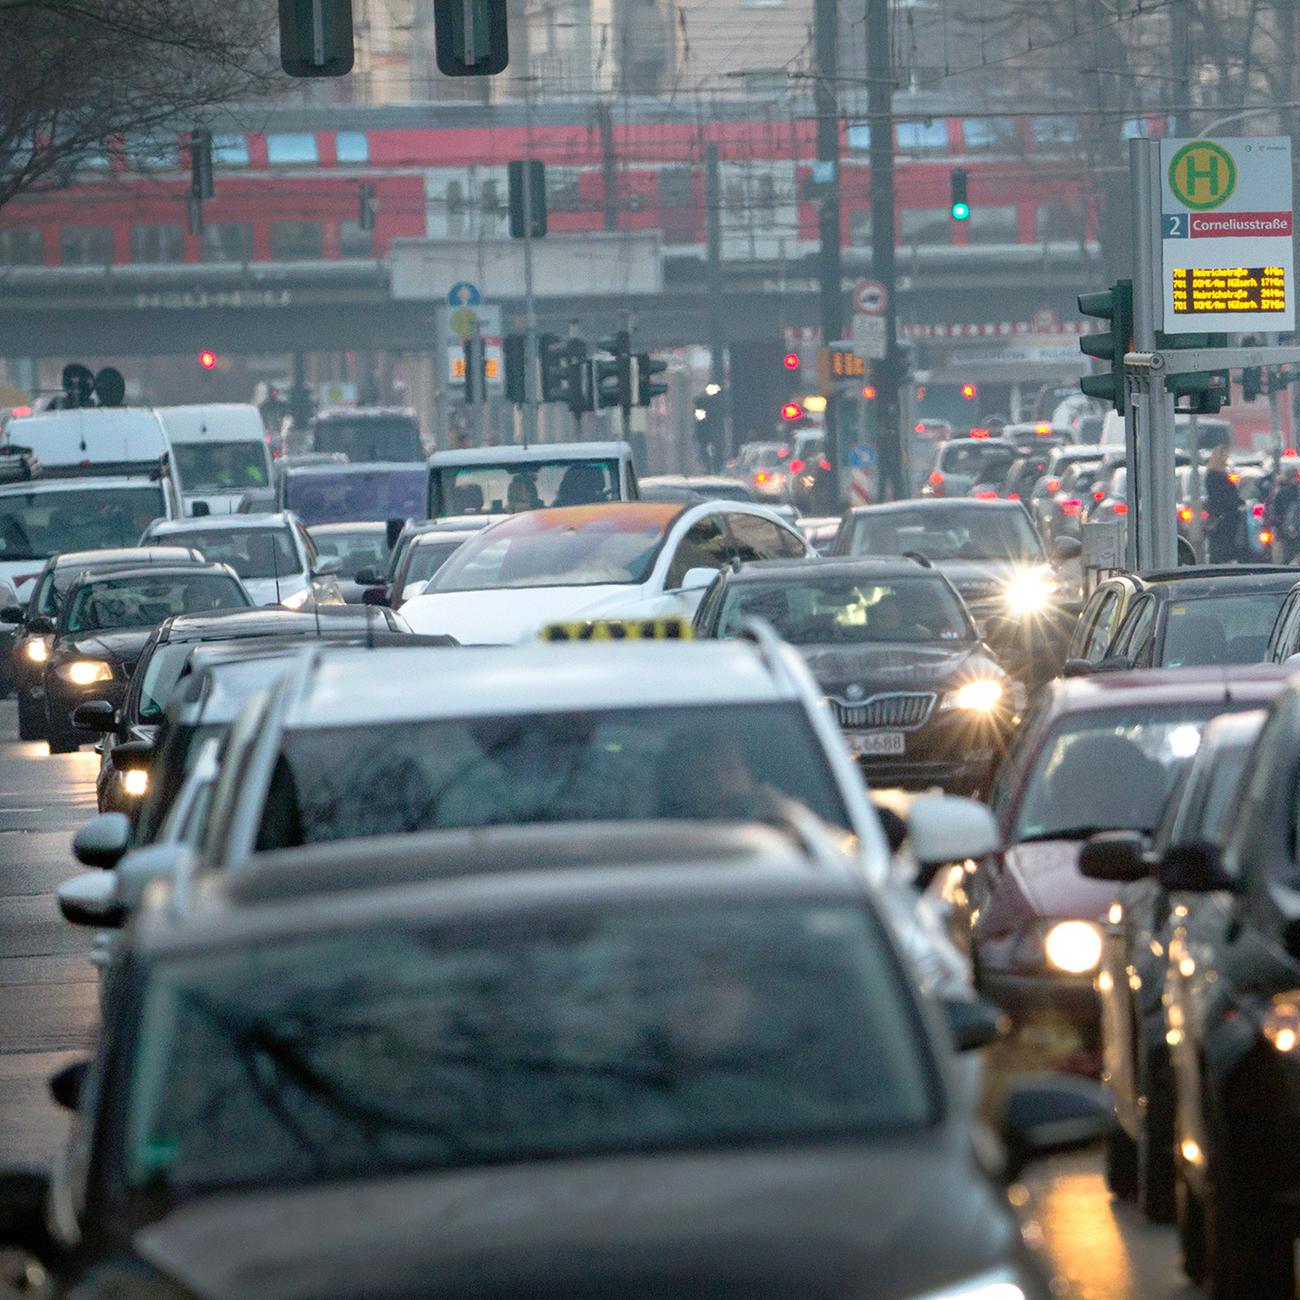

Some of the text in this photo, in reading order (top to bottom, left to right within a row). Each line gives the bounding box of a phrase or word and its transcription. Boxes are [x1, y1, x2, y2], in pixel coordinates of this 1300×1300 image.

[1186, 156, 1219, 196] H
[1169, 216, 1181, 235] 2
[1193, 219, 1288, 231] Corneliusstraße
[1173, 268, 1186, 277] 701
[1174, 279, 1187, 288] 701
[1174, 290, 1187, 299] 701
[1174, 301, 1187, 310] 701
